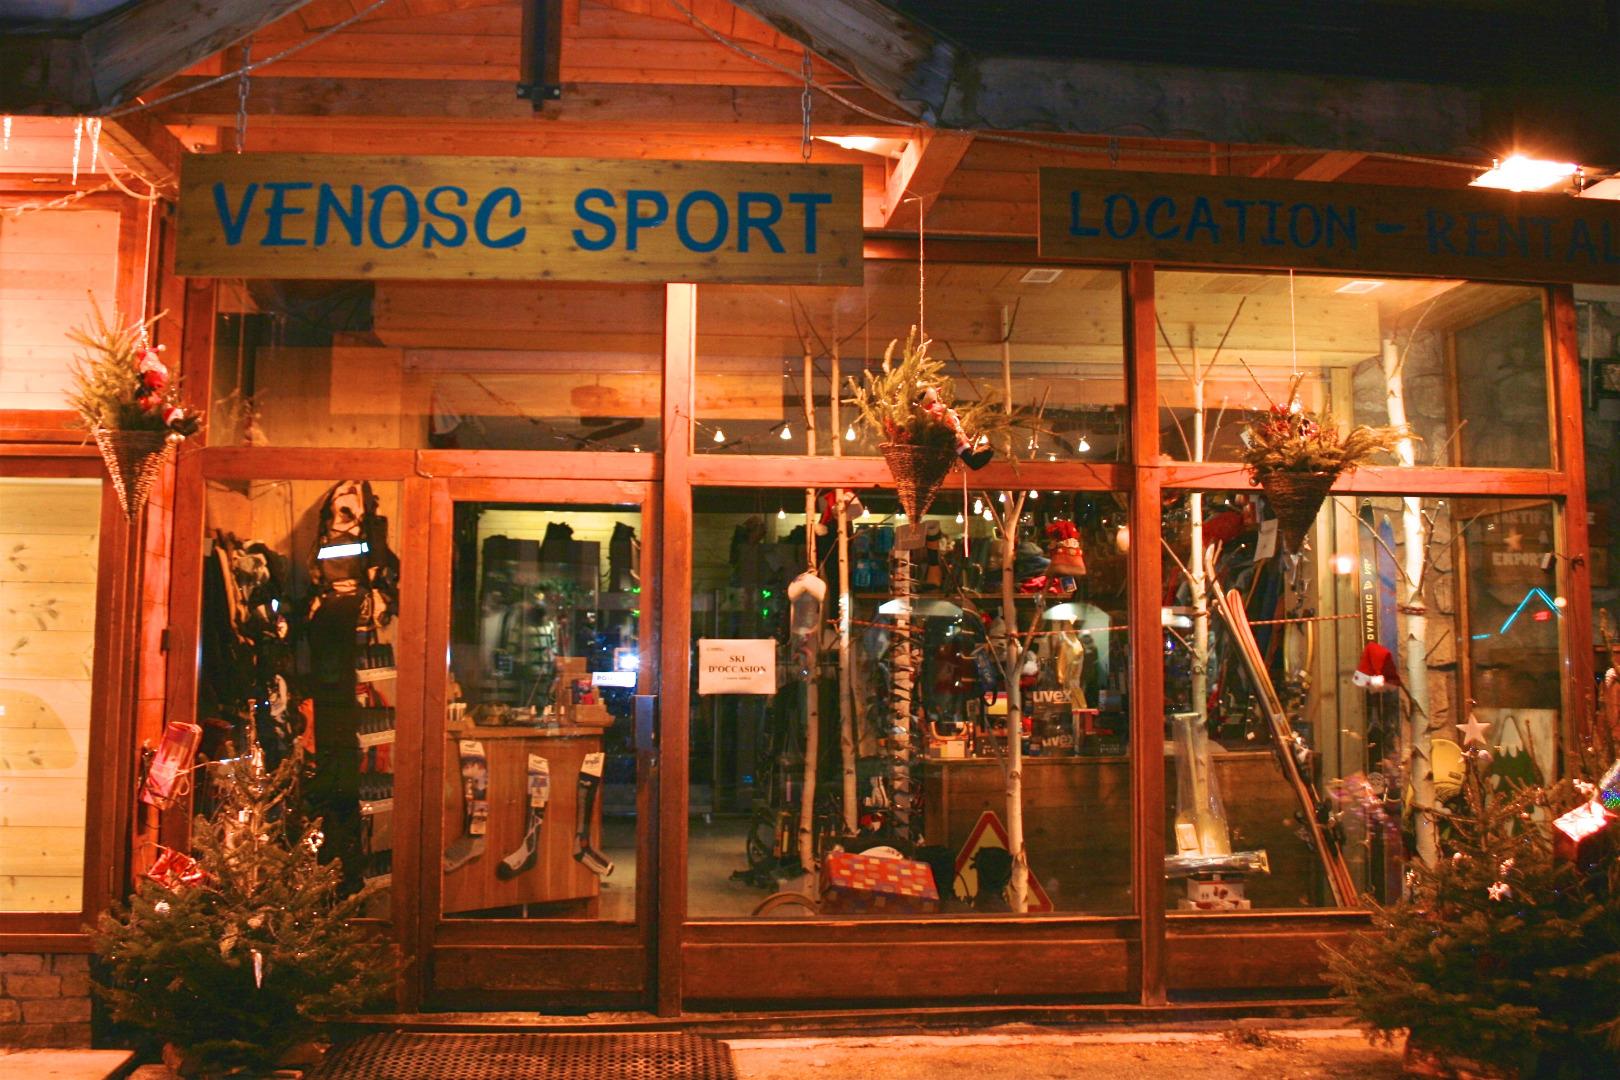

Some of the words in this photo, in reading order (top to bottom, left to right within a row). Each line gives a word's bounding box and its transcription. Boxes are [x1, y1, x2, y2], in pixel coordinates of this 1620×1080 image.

[212, 182, 526, 249] VENOSC
[573, 188, 832, 254] SPORT
[1069, 190, 1358, 250] LOCATION
[1424, 207, 1620, 264] RENTAL
[1365, 593, 1375, 640] DYNAMIC
[708, 665, 767, 673] D'OCCASION
[729, 655, 745, 663] SKI
[1032, 690, 1072, 703] uvex
